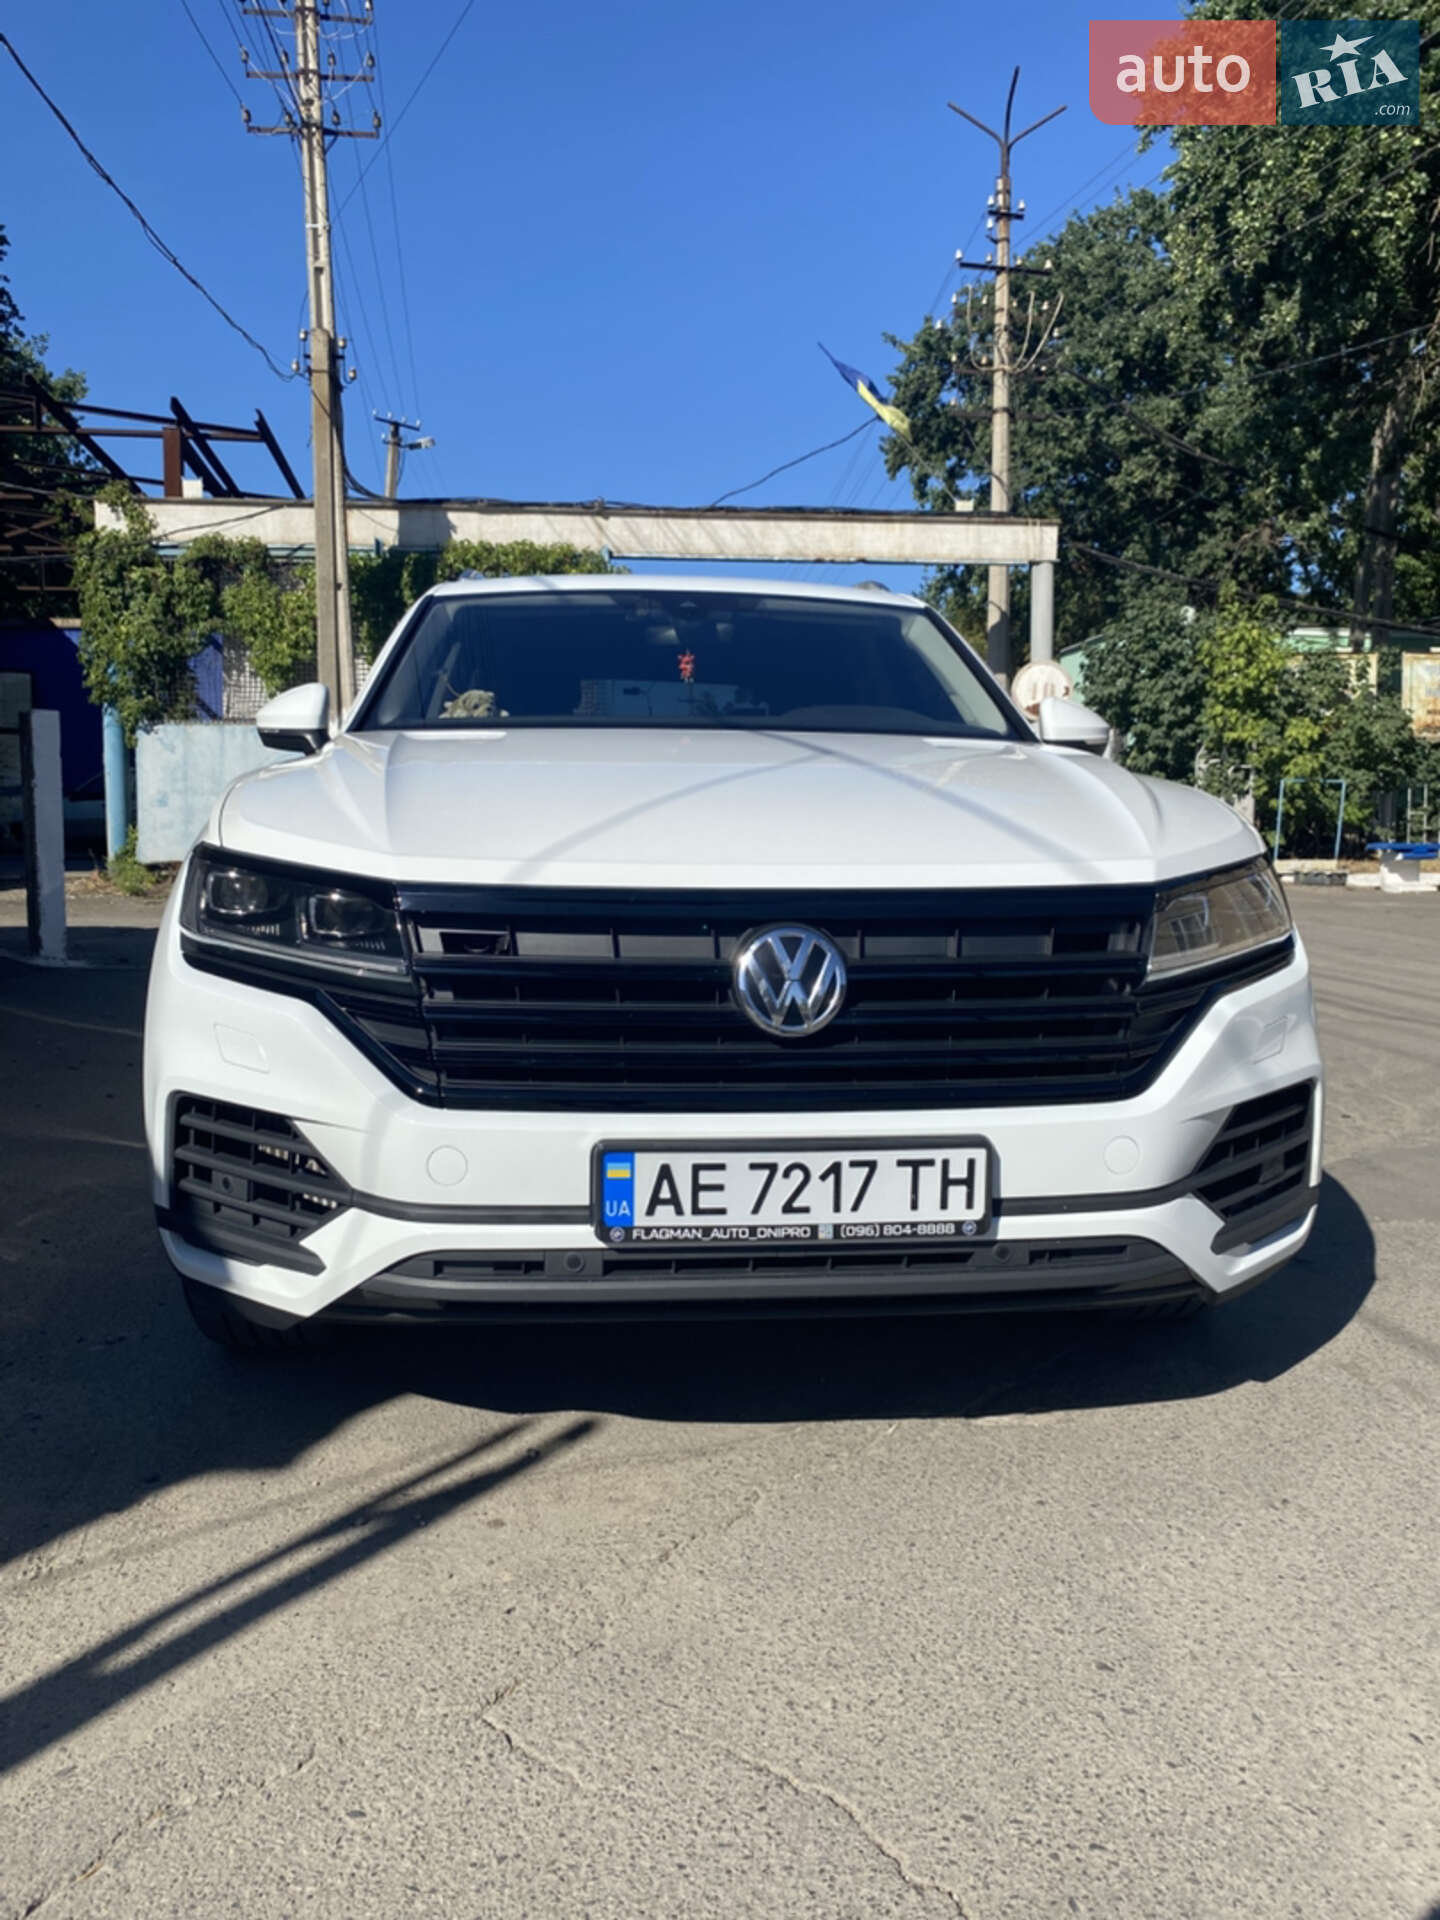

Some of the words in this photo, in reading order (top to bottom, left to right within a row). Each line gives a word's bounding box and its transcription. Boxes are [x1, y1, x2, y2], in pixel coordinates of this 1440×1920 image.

[645, 1163, 727, 1216] AE
[748, 1160, 878, 1215] 7217
[896, 1157, 976, 1212] TH
[606, 1200, 631, 1217] UA
